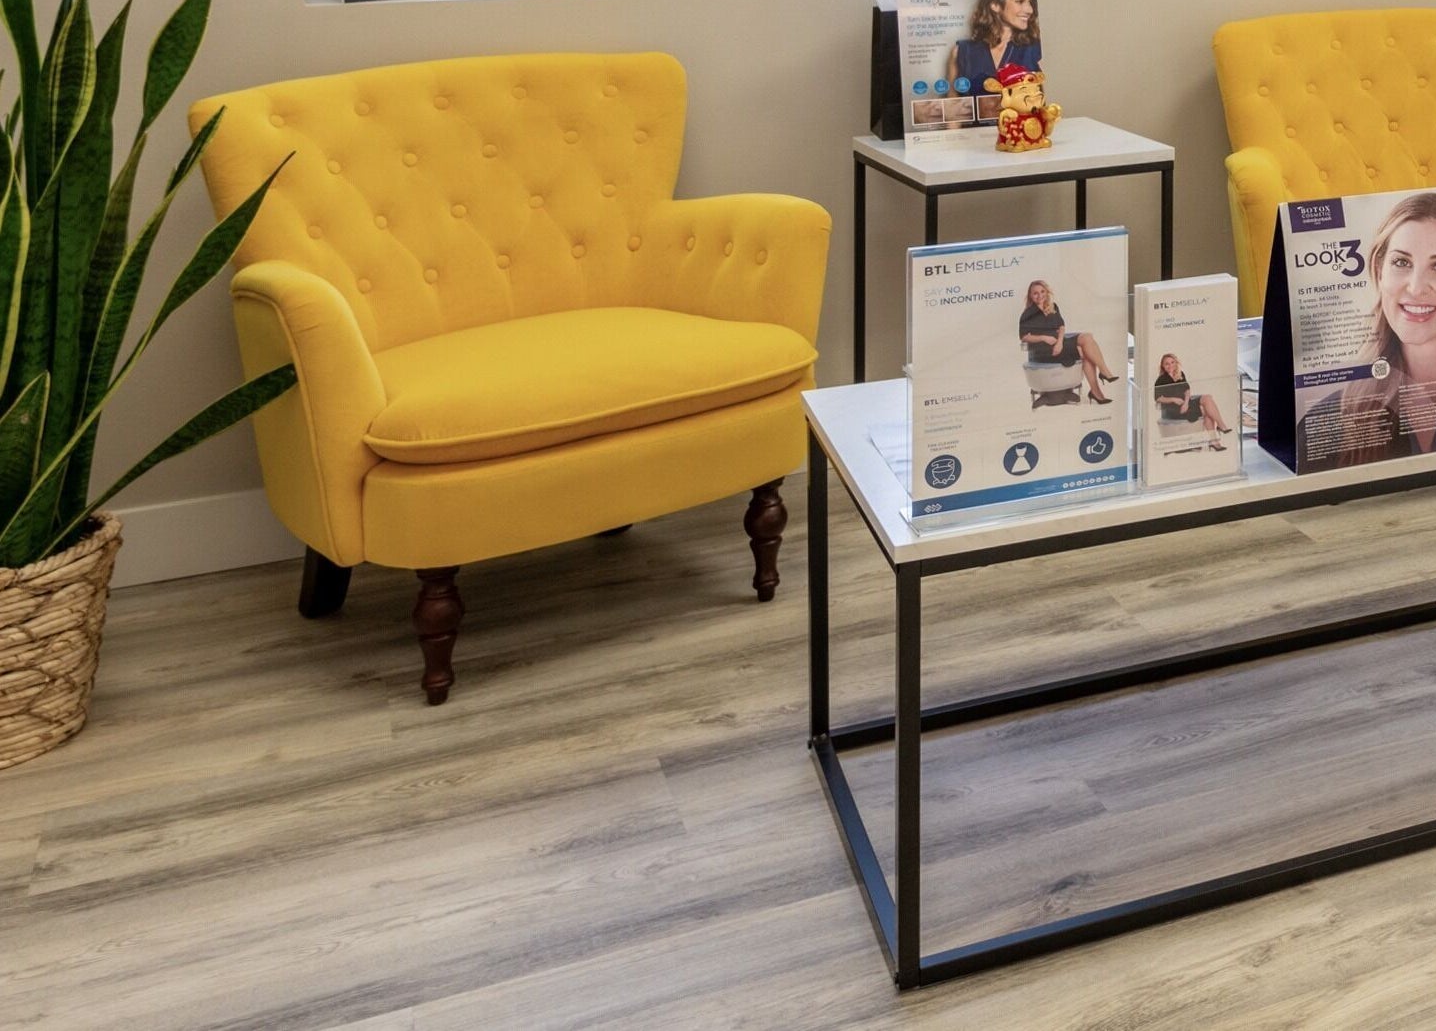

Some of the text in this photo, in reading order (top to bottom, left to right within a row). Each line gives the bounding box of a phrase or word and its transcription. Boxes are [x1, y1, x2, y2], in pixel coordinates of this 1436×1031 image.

[1300, 205, 1331, 214] BOTOX
[1295, 248, 1346, 268] LOOK
[1339, 239, 1366, 277] 3
[925, 265, 951, 277] BTL
[1332, 263, 1343, 271] OF
[946, 285, 961, 294] NO
[1313, 284, 1336, 293] RIGHT
[1337, 282, 1352, 291] FOR
[1353, 280, 1367, 289] ME?
[925, 289, 1015, 307] TO INCONTINENCE
[1153, 302, 1170, 310] BTL
[1163, 319, 1205, 329] INCONTINENCE
[923, 398, 939, 407] BTL
